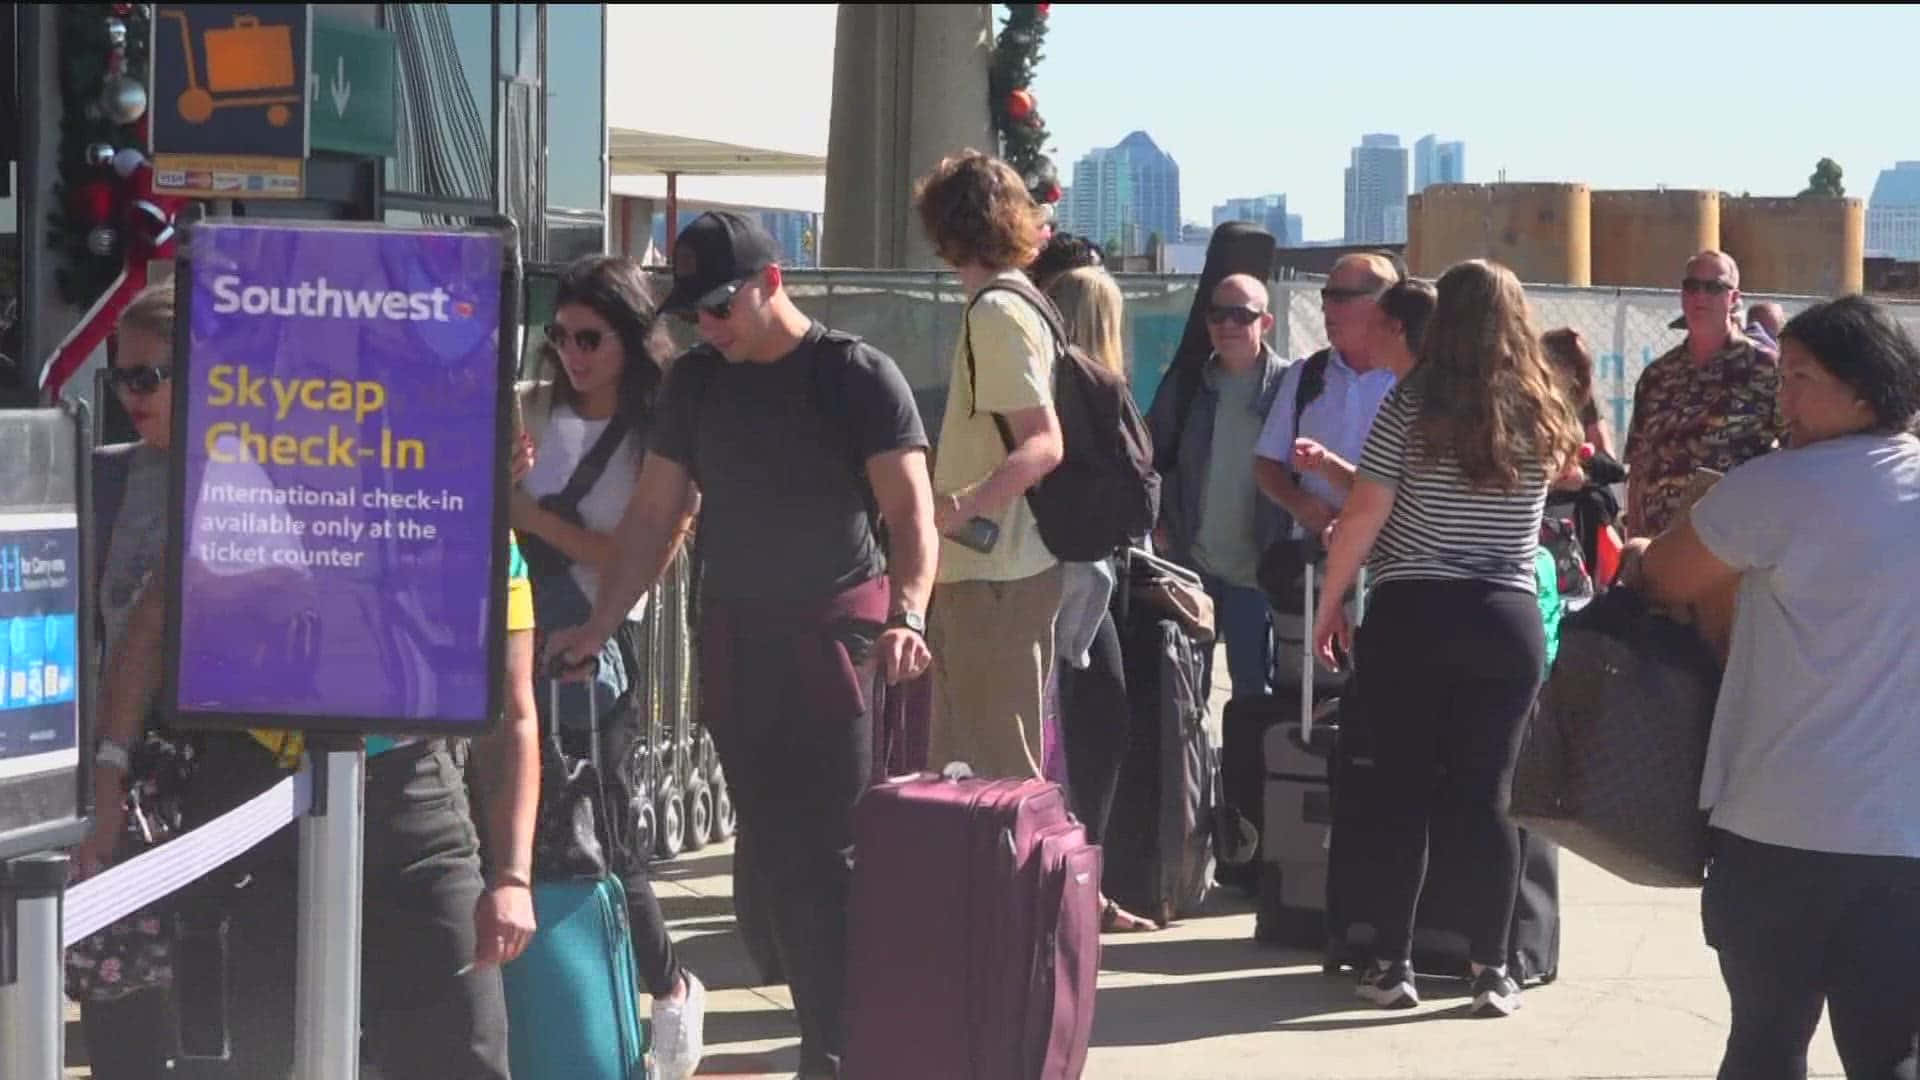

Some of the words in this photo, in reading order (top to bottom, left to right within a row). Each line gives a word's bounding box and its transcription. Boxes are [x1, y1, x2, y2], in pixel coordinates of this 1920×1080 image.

[213, 275, 449, 322] Southwest
[207, 364, 385, 423] Skycap
[204, 422, 425, 470] Check-In
[202, 483, 355, 508] International
[362, 488, 464, 511] check-in
[201, 513, 305, 534] available
[312, 518, 362, 543] only
[369, 519, 392, 536] at
[398, 520, 437, 539] the
[201, 541, 264, 563] ticket
[272, 547, 364, 567] counter
